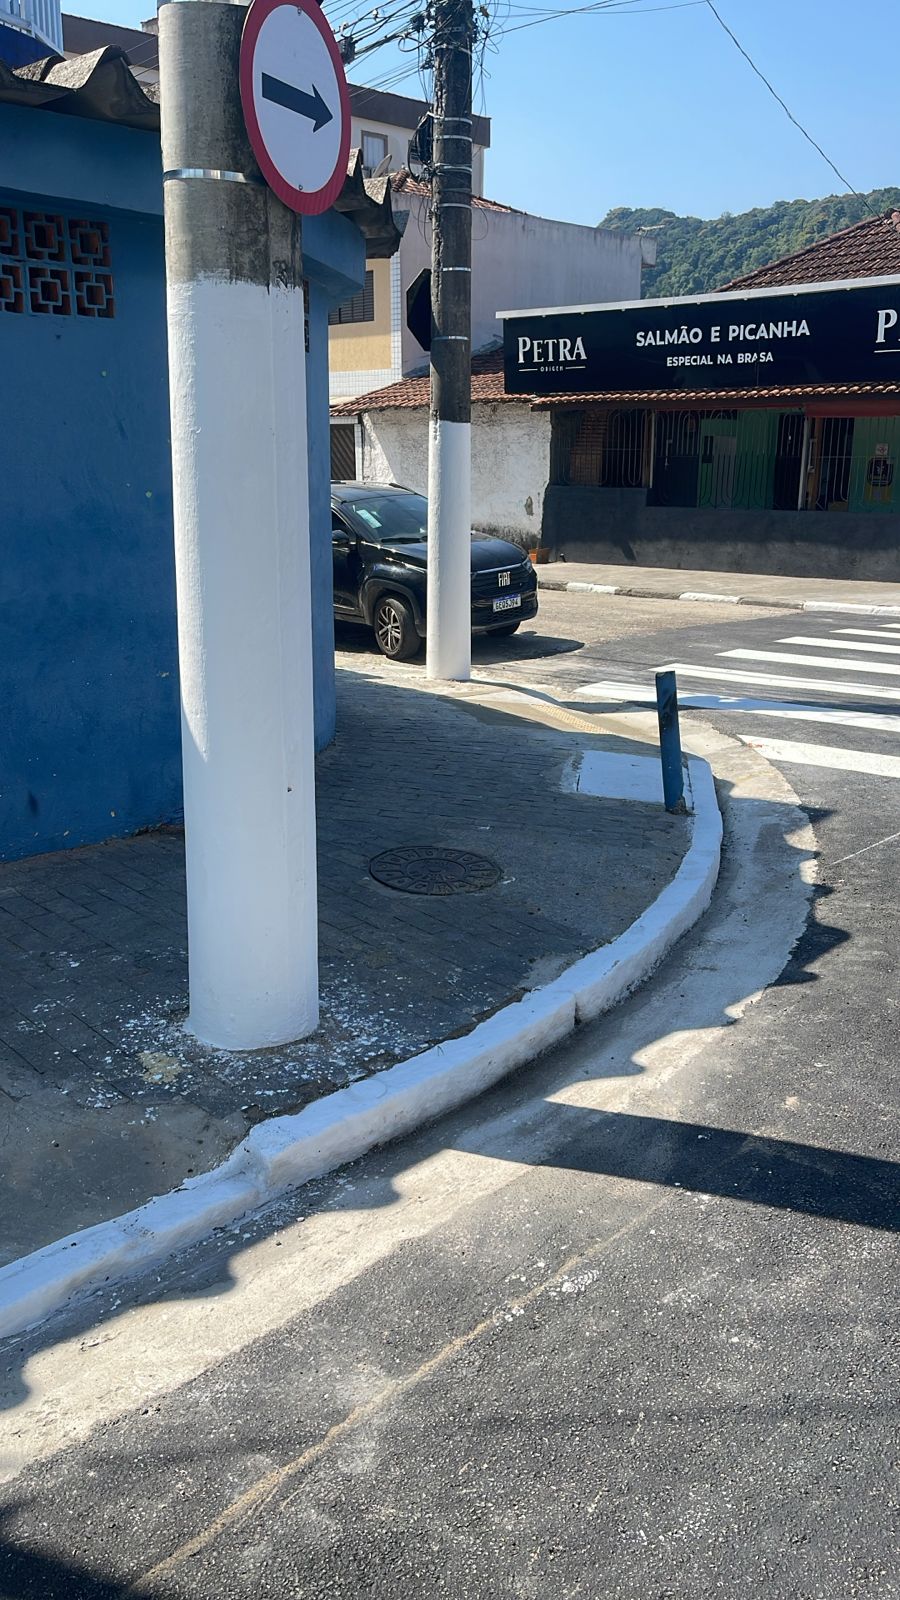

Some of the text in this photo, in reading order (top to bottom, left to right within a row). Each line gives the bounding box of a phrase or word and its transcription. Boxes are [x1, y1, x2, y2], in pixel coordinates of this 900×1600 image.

[635, 319, 811, 347] SALMÃO E PICANHA
[875, 308, 900, 343] P
[517, 337, 588, 363] PETRA
[666, 351, 774, 367] ESPECIAL NA BRASA
[498, 571, 511, 588] FIAT
